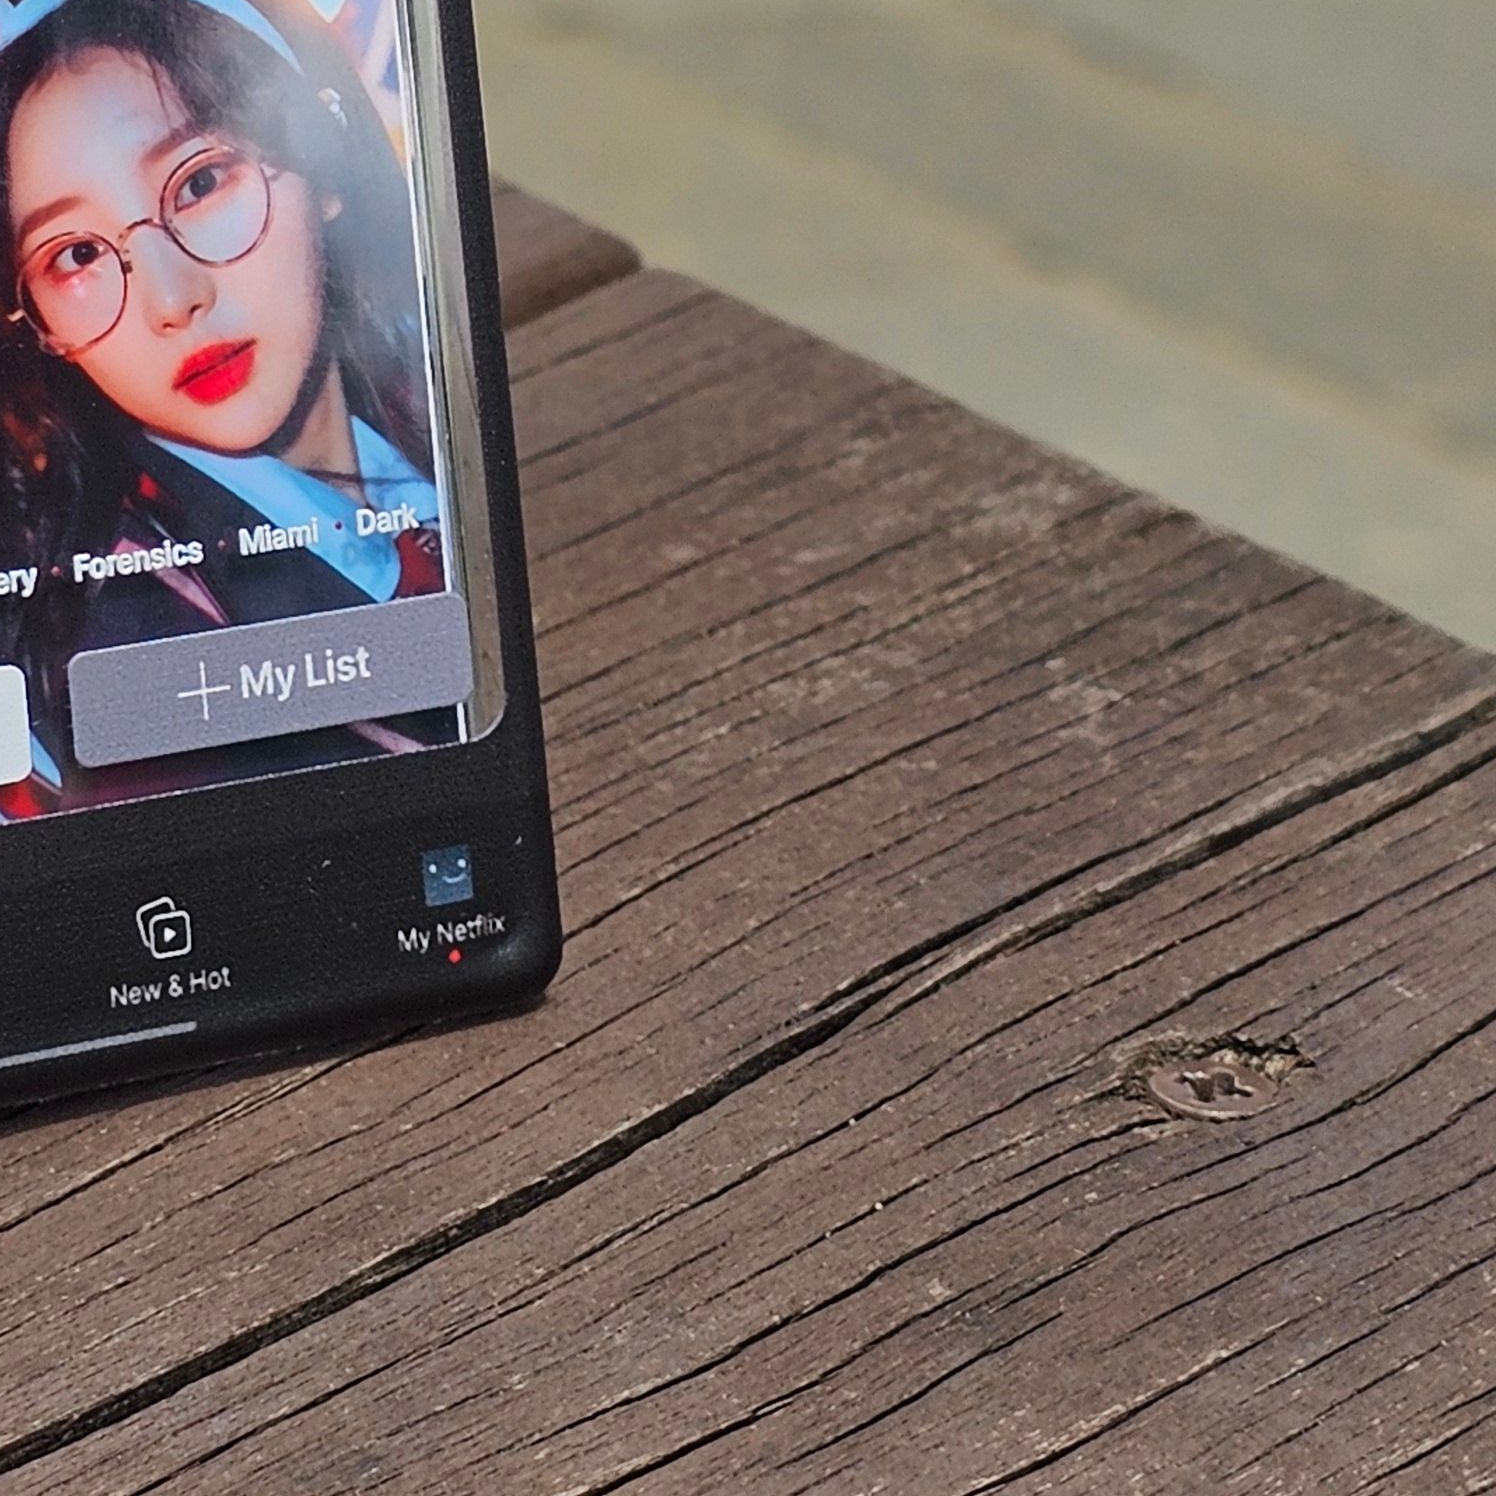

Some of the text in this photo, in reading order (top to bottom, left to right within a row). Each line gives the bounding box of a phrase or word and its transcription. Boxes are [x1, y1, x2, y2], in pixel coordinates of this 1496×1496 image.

[73, 538, 204, 583] Forensics
[238, 516, 319, 557] Miami
[356, 502, 419, 538] Dark
[239, 645, 371, 702] My List
[398, 912, 506, 954] My Netflix
[109, 965, 231, 1008] New & Hot
